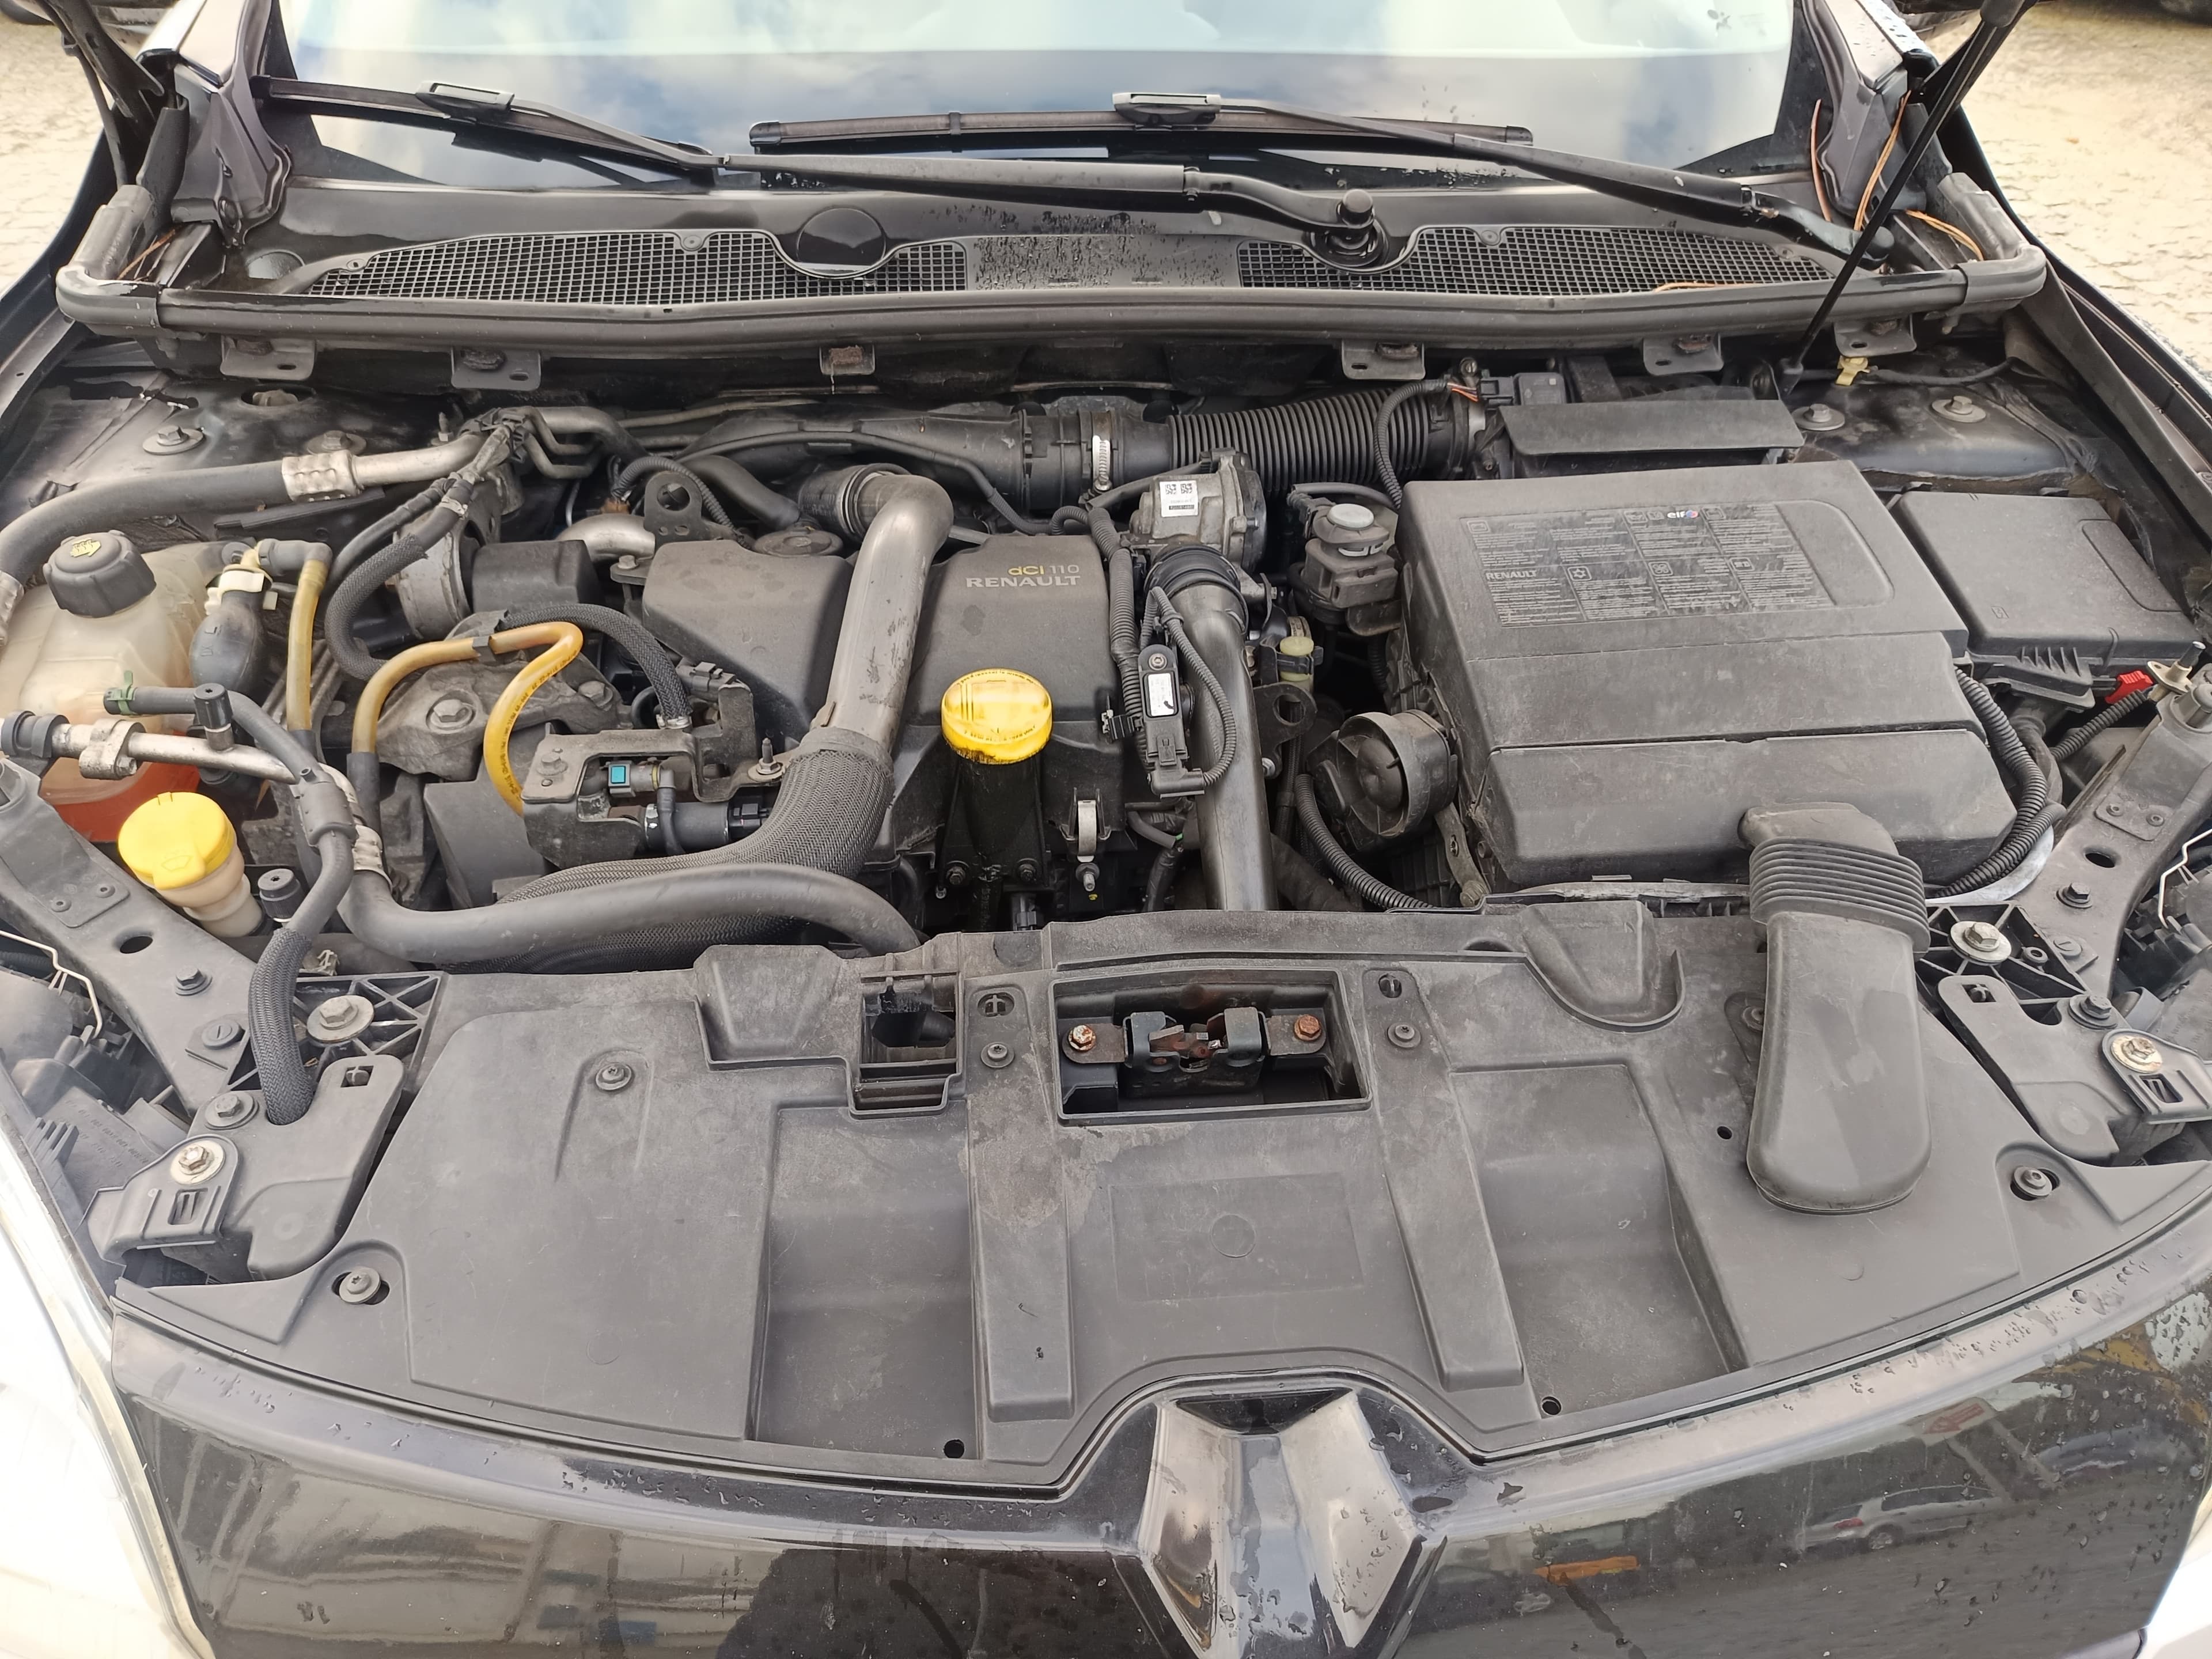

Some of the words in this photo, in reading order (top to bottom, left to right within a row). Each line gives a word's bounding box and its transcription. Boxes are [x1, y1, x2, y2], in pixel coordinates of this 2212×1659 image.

[1050, 565, 1080, 574] 110
[1486, 570, 1537, 581] RENAULT
[966, 576, 1081, 588] RENAULT
